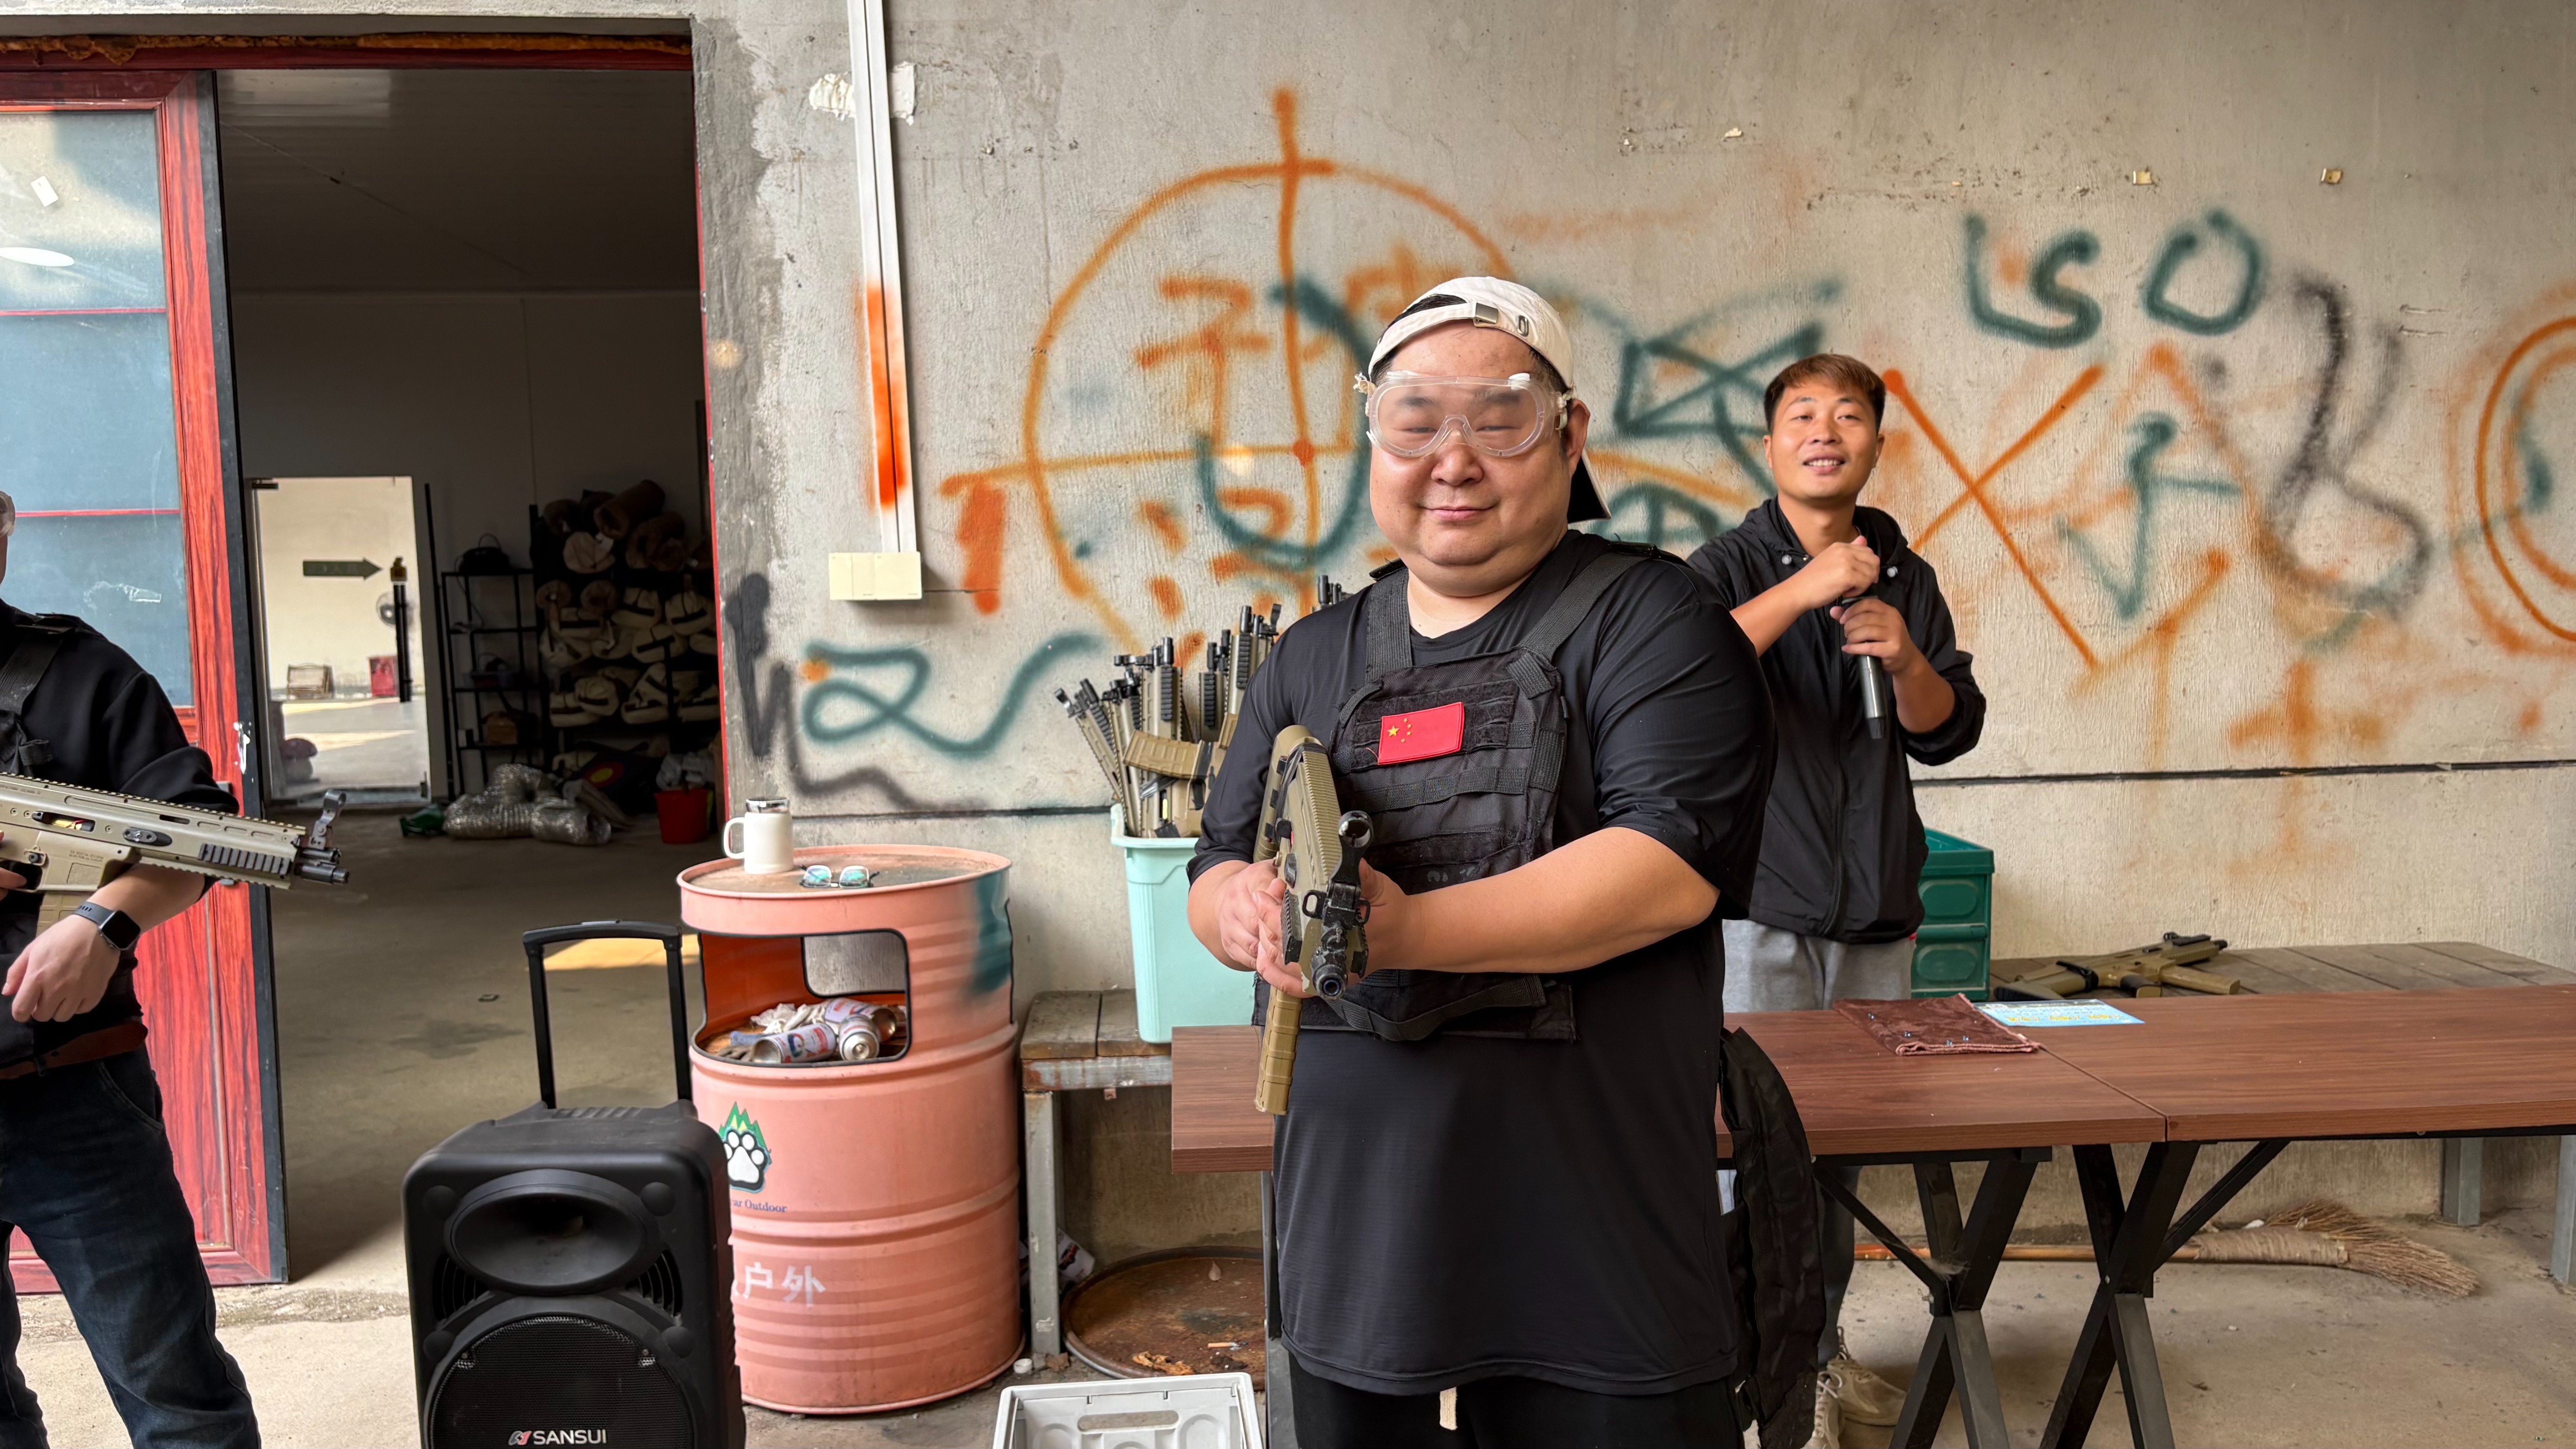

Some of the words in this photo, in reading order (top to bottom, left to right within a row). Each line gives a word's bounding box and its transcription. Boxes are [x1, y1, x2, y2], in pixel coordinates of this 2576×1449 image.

[745, 1199, 787, 1213] Outdoor
[731, 1261, 826, 1308] 户外
[533, 1429, 607, 1445] SANSUI
